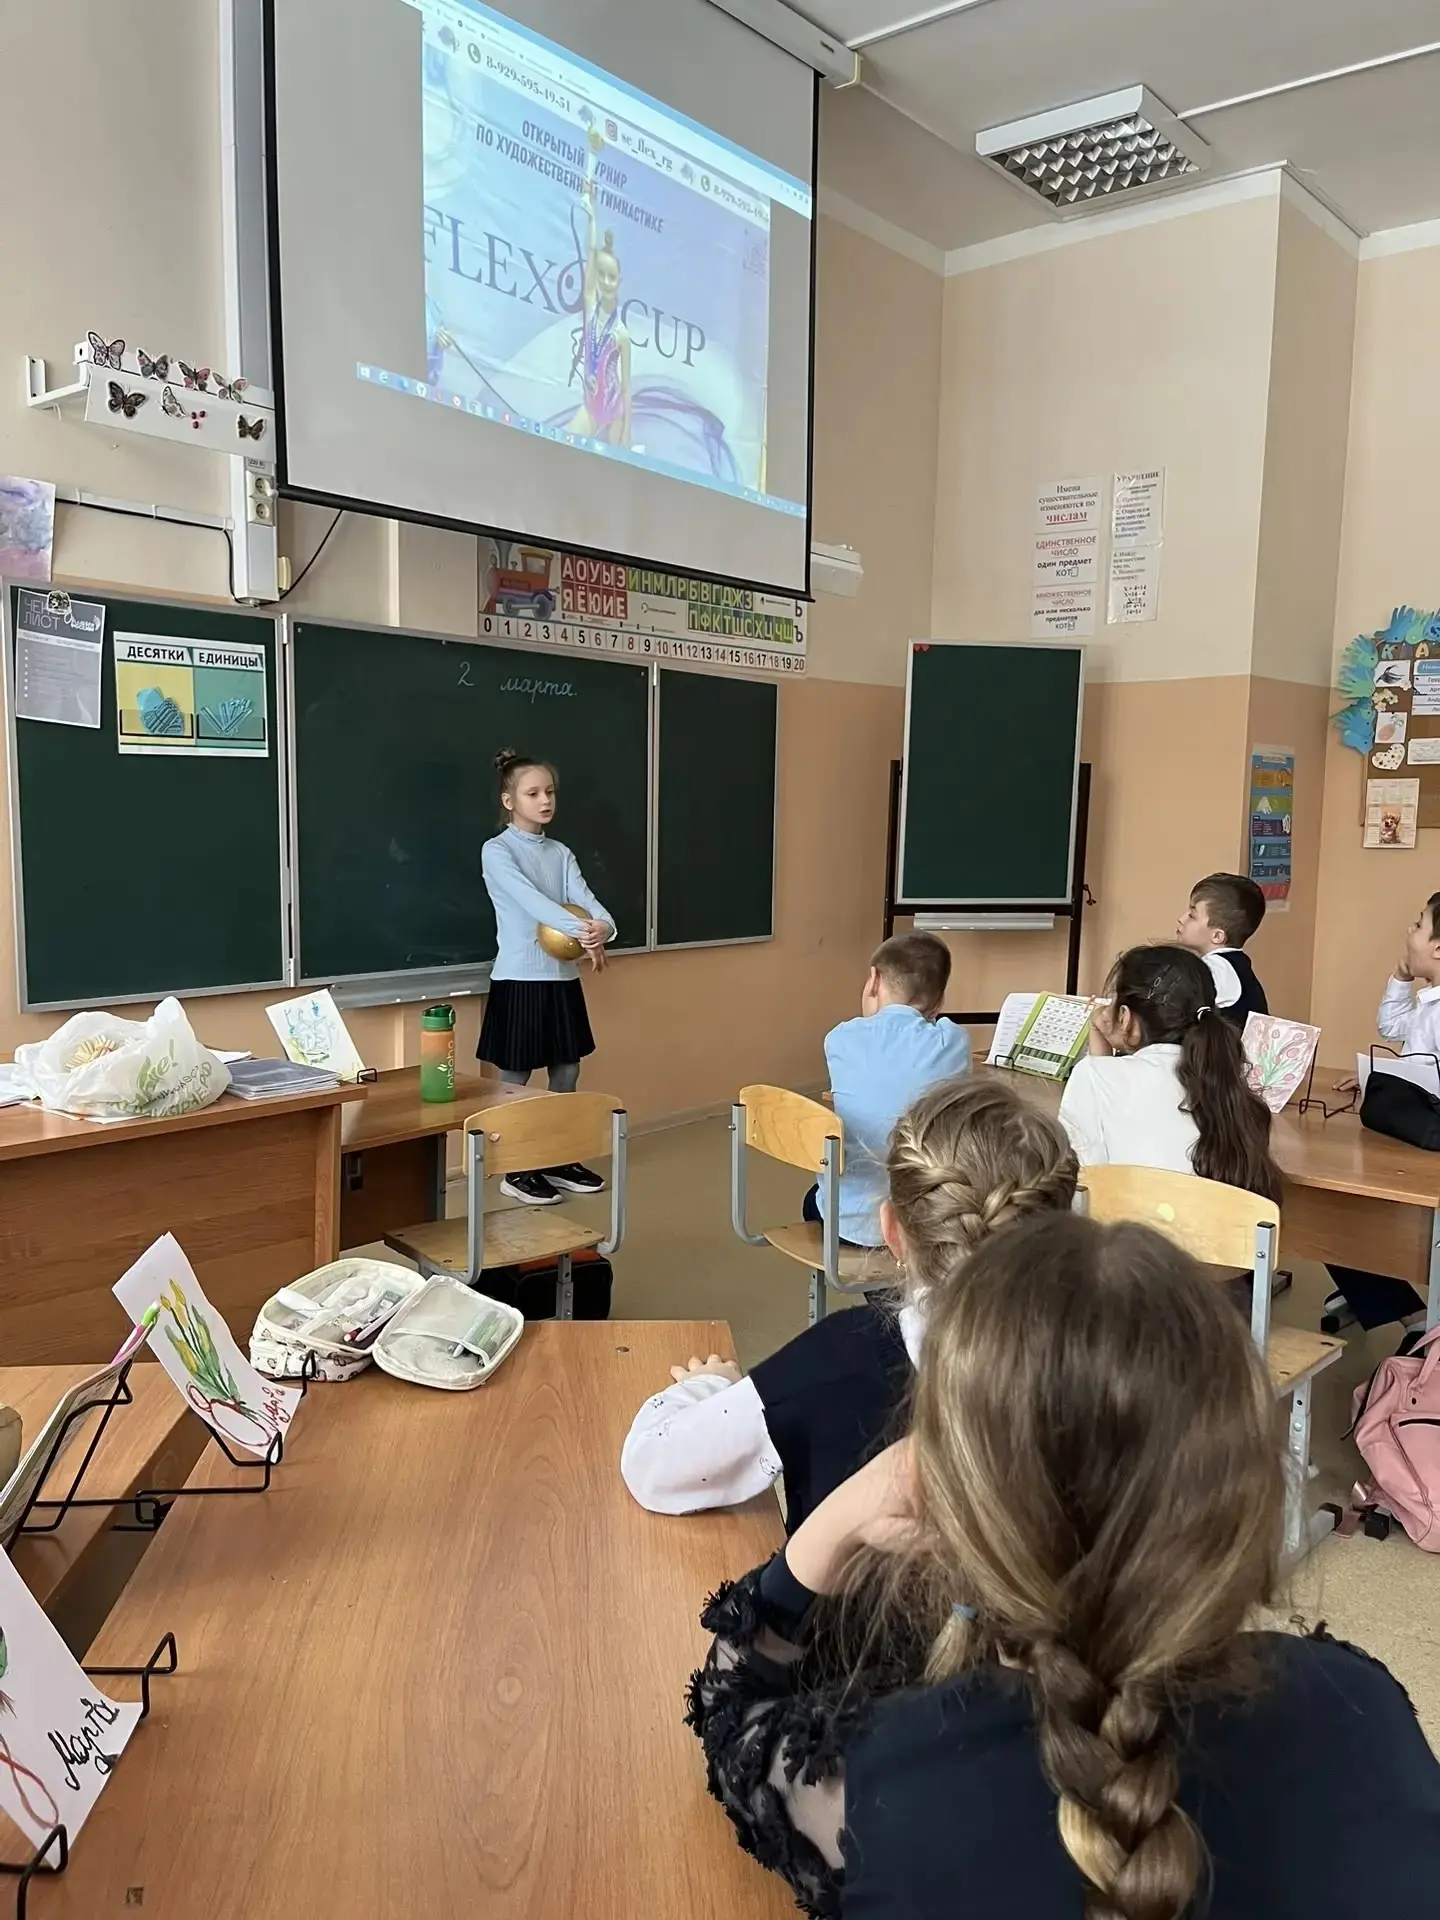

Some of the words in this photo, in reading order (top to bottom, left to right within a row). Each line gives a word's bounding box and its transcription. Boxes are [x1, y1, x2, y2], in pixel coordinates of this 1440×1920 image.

[522, 120, 585, 168] ОТКРЫТЫЙ
[476, 124, 493, 146] ПО
[600, 190, 664, 234] ГИМНАСТИКЕ
[621, 298, 706, 367] CUP
[1056, 485, 1080, 493] Имена
[1047, 512, 1087, 522] числам
[1036, 536, 1096, 549] ЕДИНСТВЕННОЕ
[1051, 548, 1078, 556] ЧИСЛО
[1059, 558, 1092, 567] предмет
[24, 611, 60, 630] ЛИСТ
[484, 618, 492, 633] 0
[504, 620, 510, 635] 1
[524, 623, 532, 637] 2
[543, 625, 550, 639] 3
[561, 628, 568, 641] 4
[578, 630, 585, 644] 5
[595, 633, 601, 646] 6
[612, 635, 618, 648] 7
[628, 637, 634, 650] 8
[644, 639, 650, 652] 9
[657, 641, 669, 655] 10
[673, 643, 683, 656] 11
[687, 645, 698, 658] 12
[701, 647, 712, 660] 13
[715, 648, 725, 661] 14
[729, 650, 740, 663] 15
[743, 652, 754, 664] 16
[757, 654, 767, 666] 17
[769, 655, 779, 668] 18
[781, 657, 791, 669] 19
[794, 659, 805, 671] 20
[127, 646, 185, 661] ДЕСЯТКИ
[199, 652, 258, 668] ЕДИНИЦЫ
[457, 661, 474, 686] 2
[48, 1697, 119, 1790] Марта
